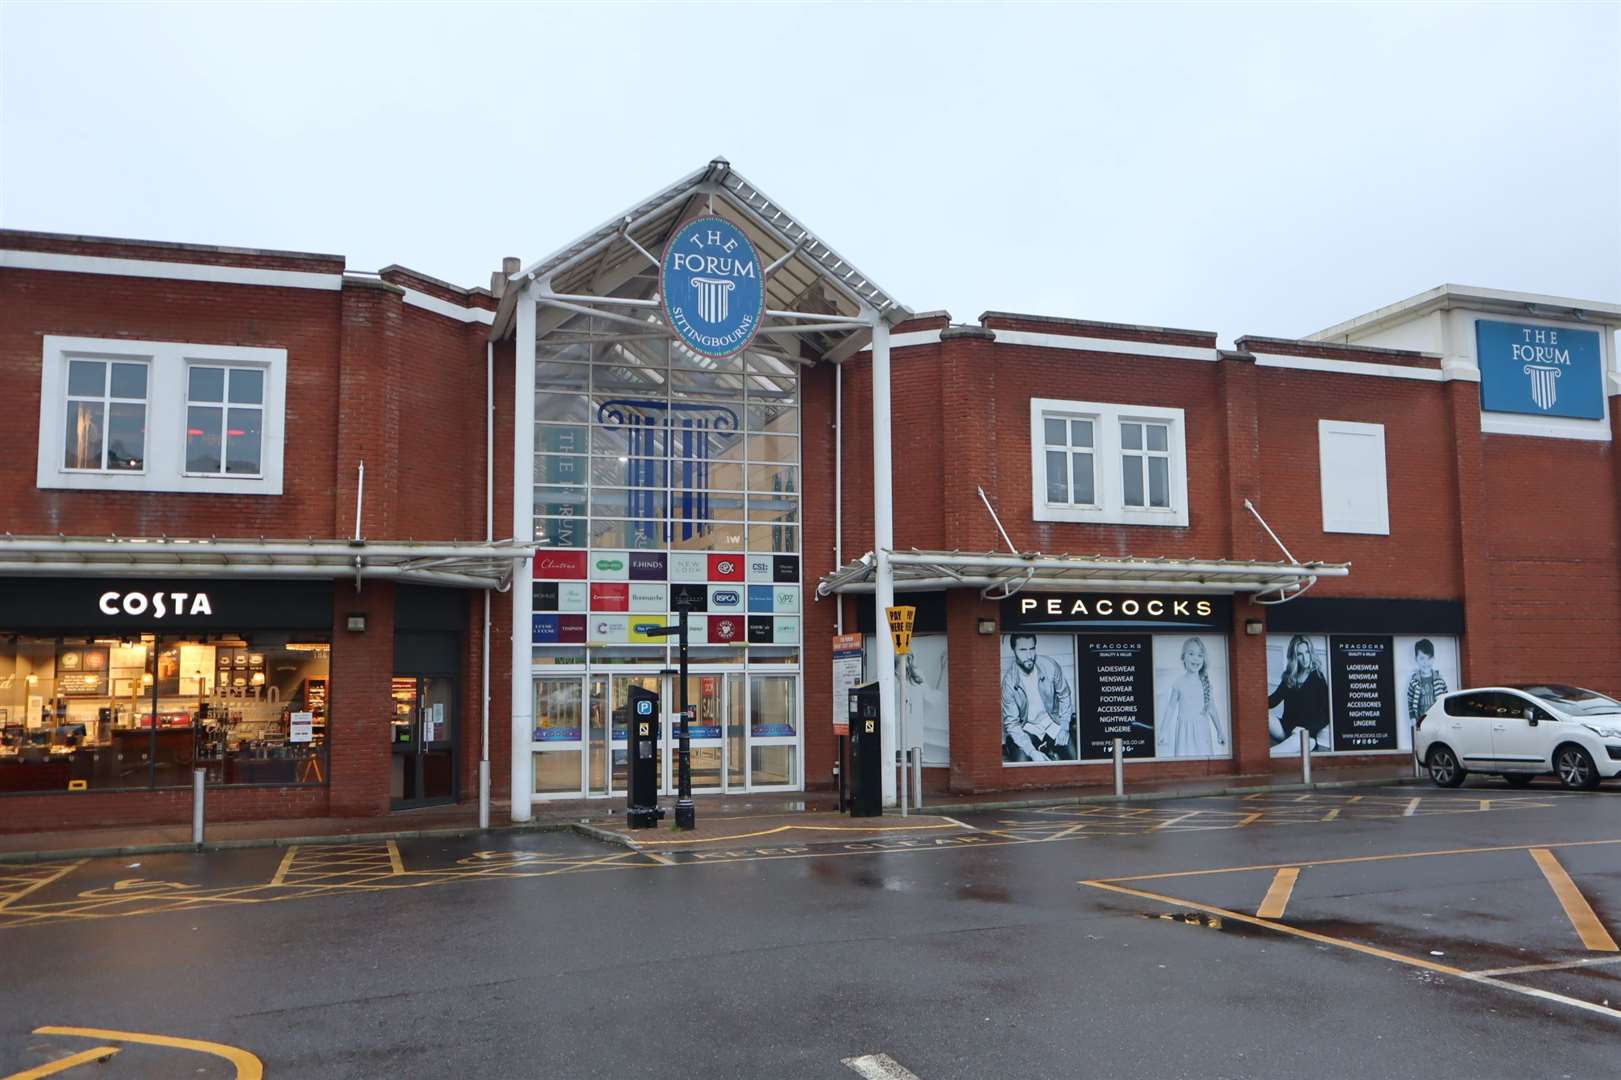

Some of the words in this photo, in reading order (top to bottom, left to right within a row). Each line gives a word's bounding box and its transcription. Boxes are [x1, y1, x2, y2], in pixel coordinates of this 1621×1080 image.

[690, 230, 738, 253] THE
[673, 252, 756, 279] FORUM
[672, 306, 753, 347] SITTINGBOURNE
[1523, 328, 1558, 345] THE
[1511, 343, 1572, 366] FORUM
[558, 481, 574, 547] FRUM
[99, 591, 212, 618] COSTA
[889, 610, 902, 621] PAY
[1021, 598, 1212, 616] PEACOCKS
[890, 622, 904, 633] HERE
[641, 702, 649, 713] P
[693, 847, 808, 859] KEEP
[844, 835, 989, 850] CLEAR
